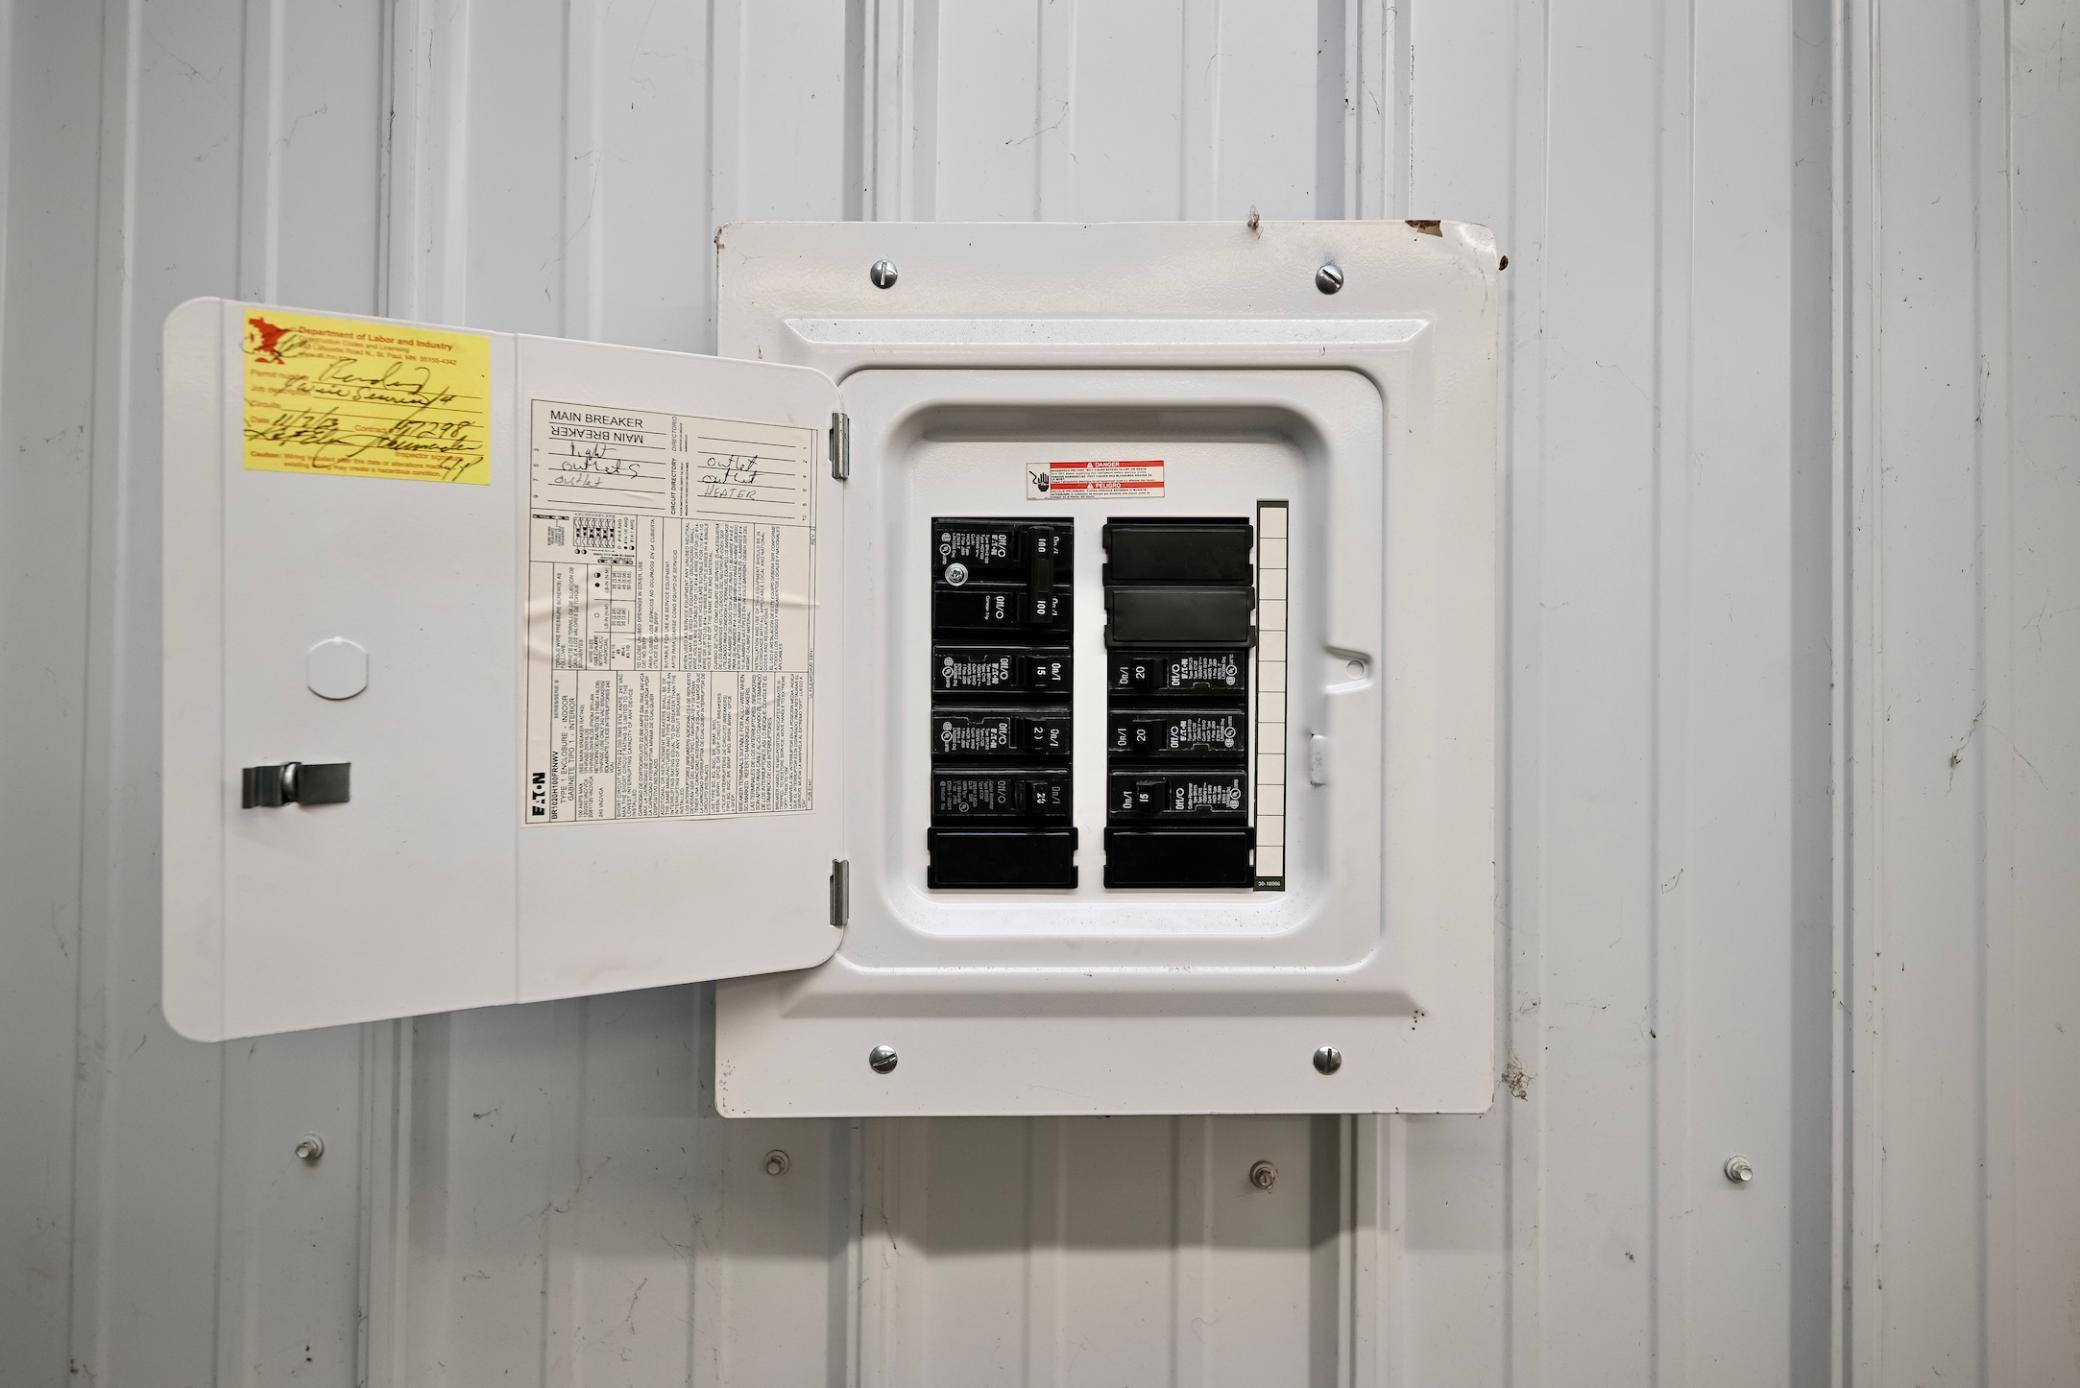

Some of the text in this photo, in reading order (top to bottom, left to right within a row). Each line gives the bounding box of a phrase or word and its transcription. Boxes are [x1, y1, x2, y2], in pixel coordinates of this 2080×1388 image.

[299, 327, 453, 351] Department of Labor and Industry
[551, 410, 642, 428] MAIN BREAKER
[552, 427, 643, 443] MAIN BREAKER
[705, 484, 756, 500] HEATER
[1038, 539, 1046, 552] 100
[1037, 600, 1046, 615] 100
[1037, 666, 1046, 675] 15
[1136, 666, 1145, 679] 20
[1137, 729, 1146, 741] 20
[1139, 794, 1149, 802] 15
